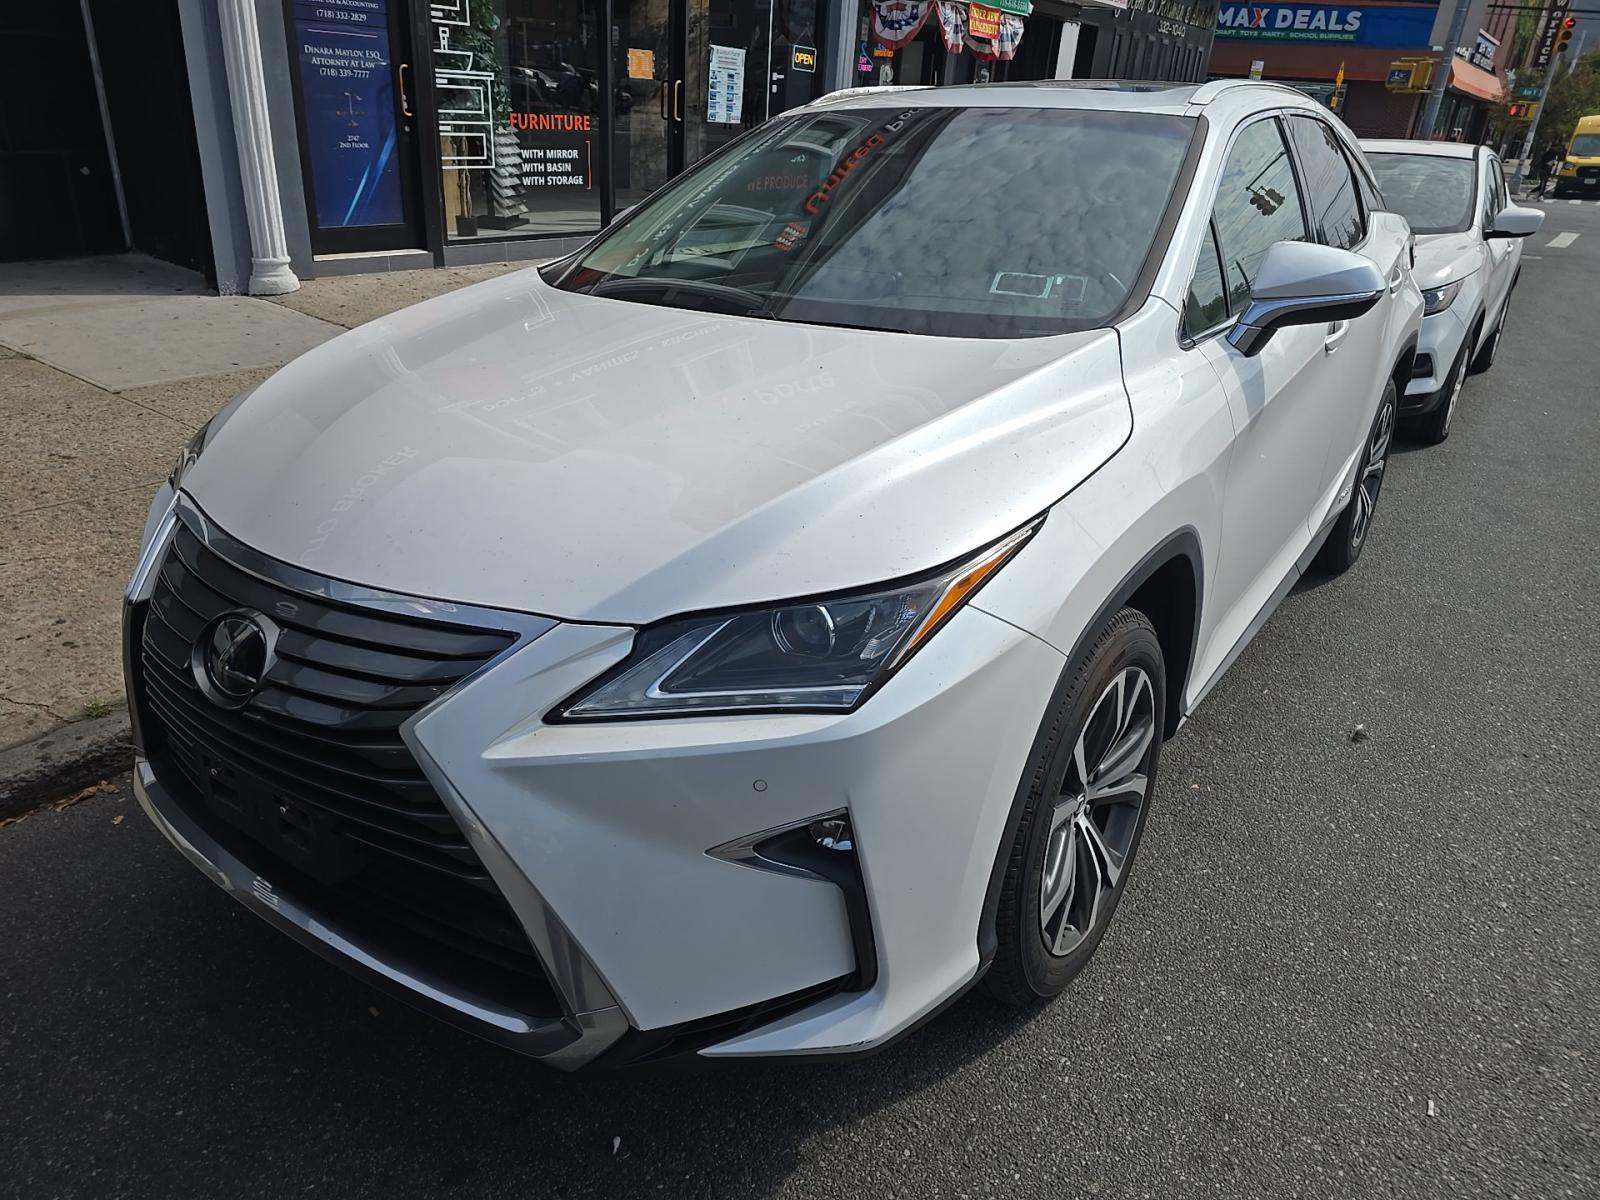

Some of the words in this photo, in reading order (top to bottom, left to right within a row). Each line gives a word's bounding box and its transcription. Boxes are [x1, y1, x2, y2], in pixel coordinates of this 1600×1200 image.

[316, 9, 335, 18] (718)
[336, 11, 367, 21] 332-2829
[1218, 7, 1270, 28] MAX
[1274, 8, 1363, 32] DEALS
[312, 57, 349, 67] ATTORNEY
[350, 60, 359, 68] AT
[361, 60, 376, 68] LAW
[794, 52, 814, 66] OPEN
[320, 67, 338, 77] (718)
[340, 69, 370, 78] 339-7777
[508, 112, 591, 131] FURNITURE
[520, 149, 544, 159] WITH
[546, 149, 579, 159] MIRROR
[522, 162, 545, 173] WITH
[546, 162, 572, 172] BASIN
[522, 176, 545, 186] WITH
[547, 175, 584, 186] STORAGE
